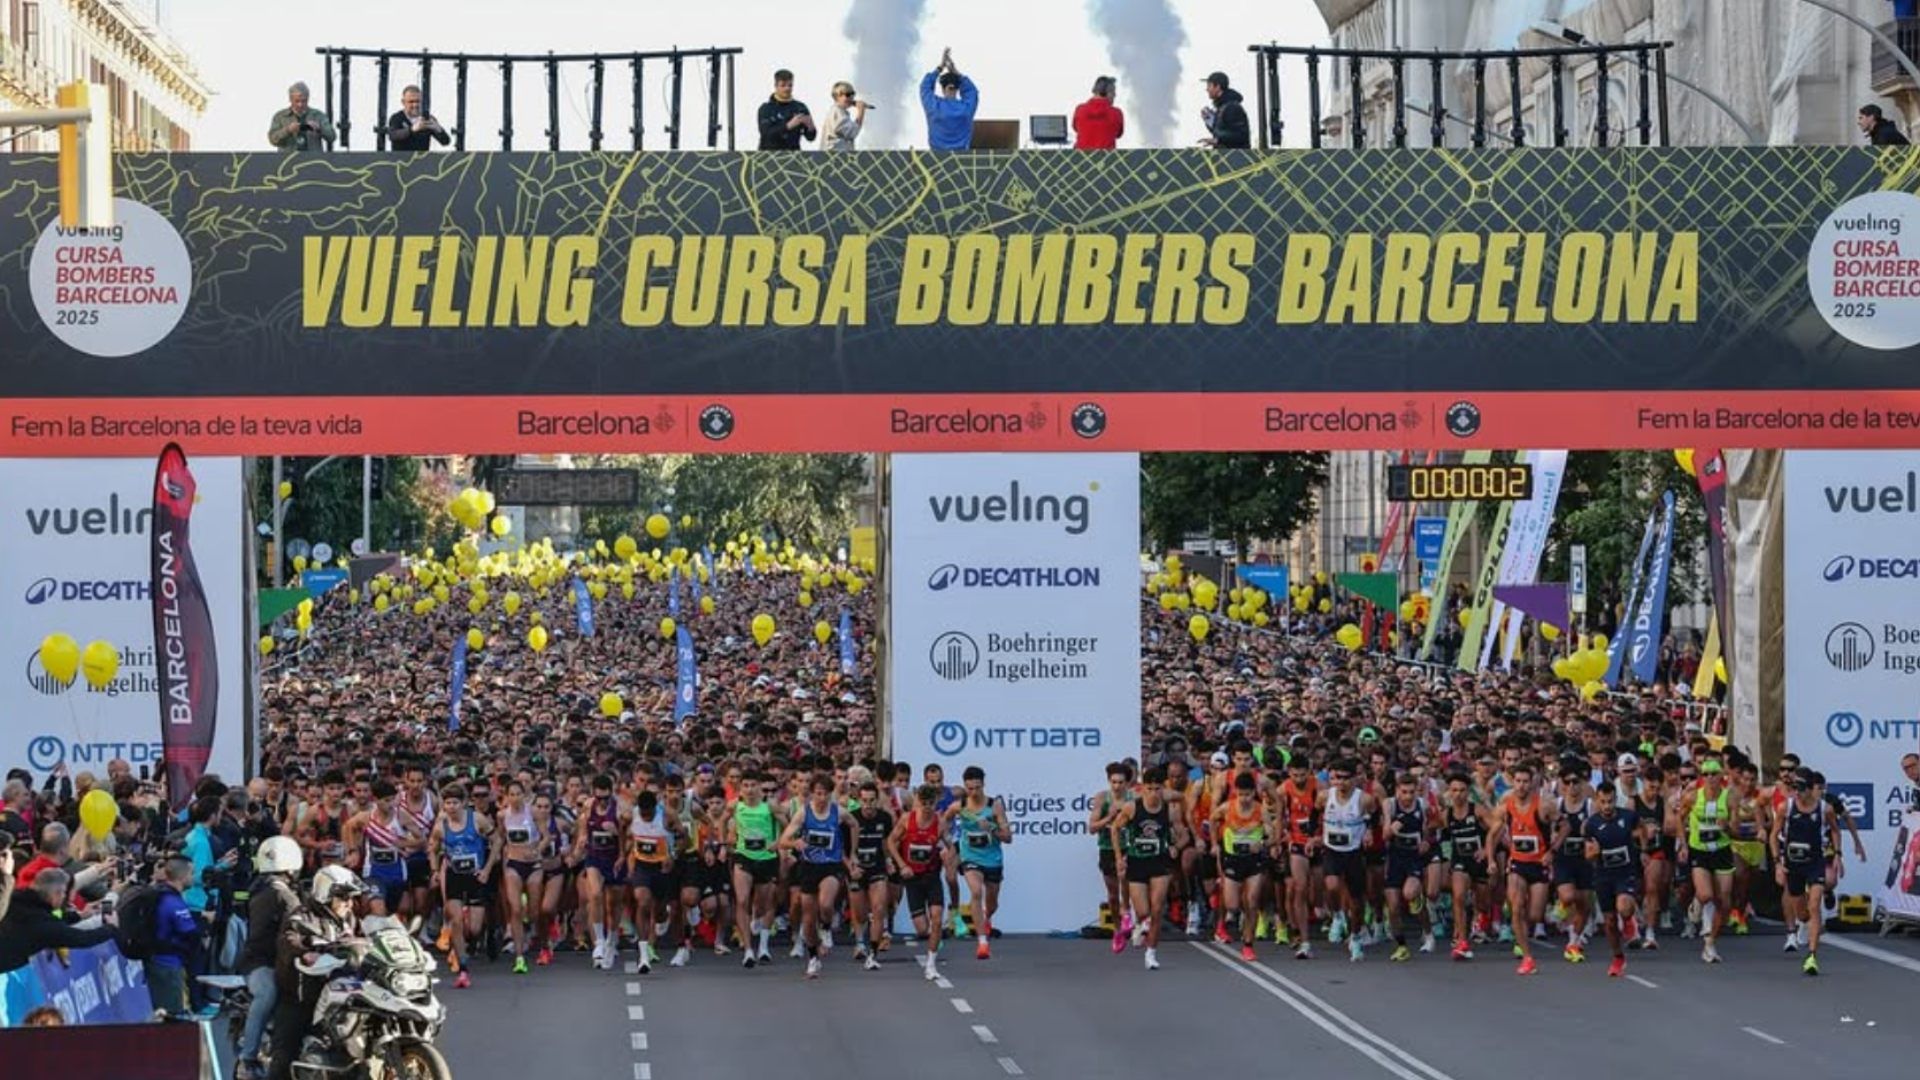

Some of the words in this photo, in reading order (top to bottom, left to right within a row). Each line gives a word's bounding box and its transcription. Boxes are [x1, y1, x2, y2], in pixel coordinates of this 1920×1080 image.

[1833, 212, 1902, 235] vueling
[55, 246, 123, 264] CURSA
[1833, 240, 1900, 257] CURSA
[55, 266, 155, 284] BOMBERS
[1833, 260, 1920, 277] BOMBER
[302, 234, 600, 328] VUELING
[620, 233, 868, 326] CURSA
[896, 232, 1256, 325] BOMBERS
[1276, 231, 1699, 324] BARCELONA
[55, 286, 178, 304] BARCELONA
[55, 309, 100, 325] 2025
[1833, 302, 1876, 318] 2025
[11, 416, 63, 436] Fem
[68, 415, 86, 435] la
[91, 416, 200, 436] Barcelona
[207, 415, 234, 435] de
[240, 414, 259, 434] la
[264, 417, 311, 435] teva
[316, 414, 363, 434] vida
[517, 410, 650, 436] Barcelona
[890, 408, 1023, 434] Barcelona
[1265, 407, 1397, 432] Barcelona
[1637, 409, 1690, 429] Fem
[1693, 407, 1710, 429] la
[1715, 408, 1824, 429] Barcelona
[1829, 407, 1858, 429] de
[1864, 407, 1881, 429] la
[26, 492, 153, 535] vuelin
[929, 480, 1089, 535] vueling
[963, 567, 1100, 587] DECATHLON
[1859, 559, 1920, 579] DECA
[61, 581, 153, 601] DECATH
[159, 530, 193, 725] BARCELONA
[988, 632, 1098, 656] Boehringer
[988, 659, 1088, 683] Ingelheim
[974, 728, 1027, 748] NTT
[1870, 720, 1920, 740] NTT
[73, 743, 126, 762] NTT
[1008, 817, 1088, 835] arcelon
